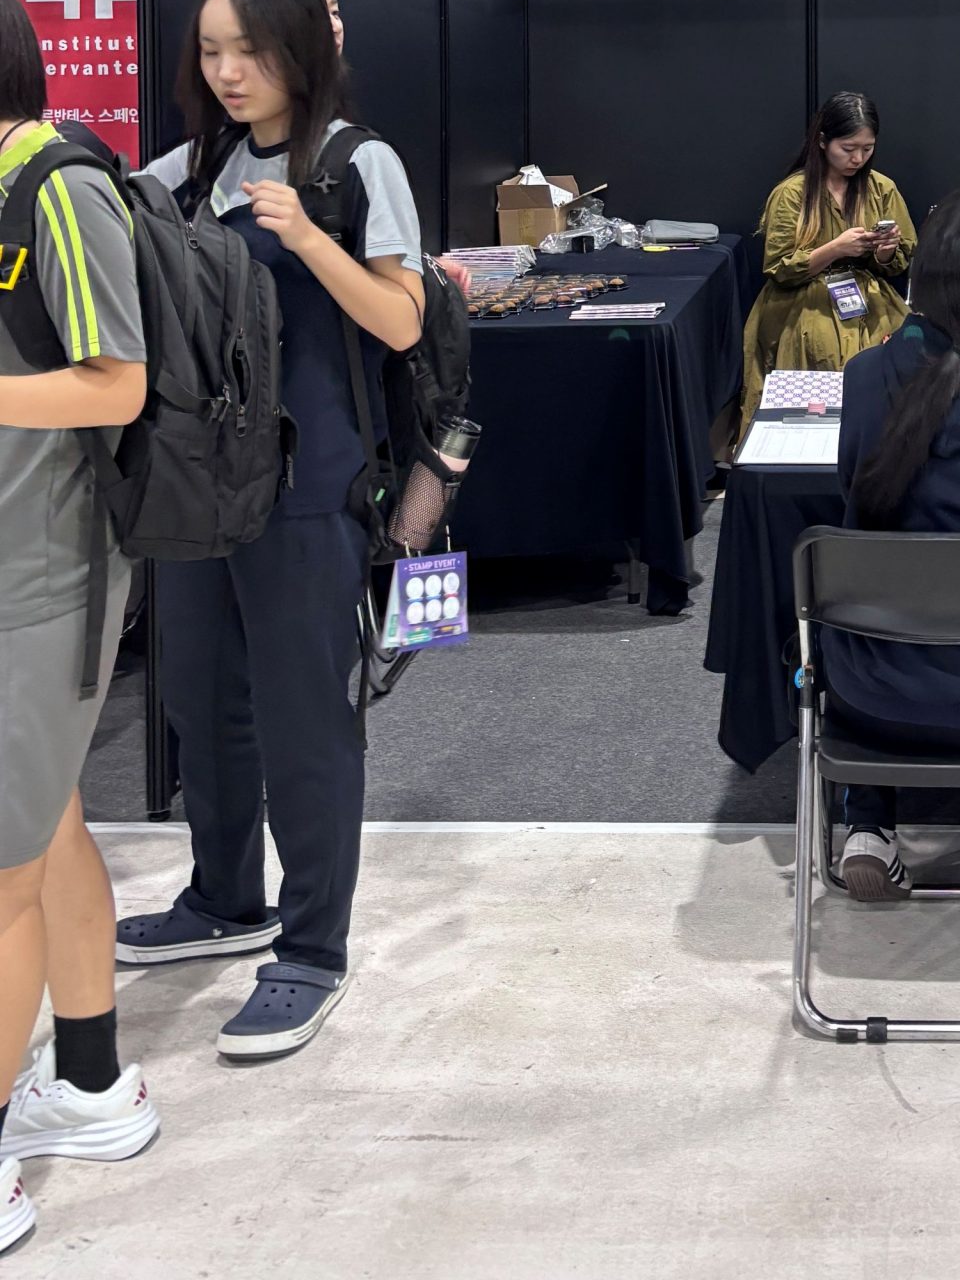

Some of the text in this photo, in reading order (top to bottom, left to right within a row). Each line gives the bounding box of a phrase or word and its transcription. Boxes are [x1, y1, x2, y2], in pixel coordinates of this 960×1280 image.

[41, 36, 135, 51] nstitut
[46, 60, 138, 76] ervante
[43, 108, 94, 123] 르반테스
[433, 558, 457, 569] EVENT
